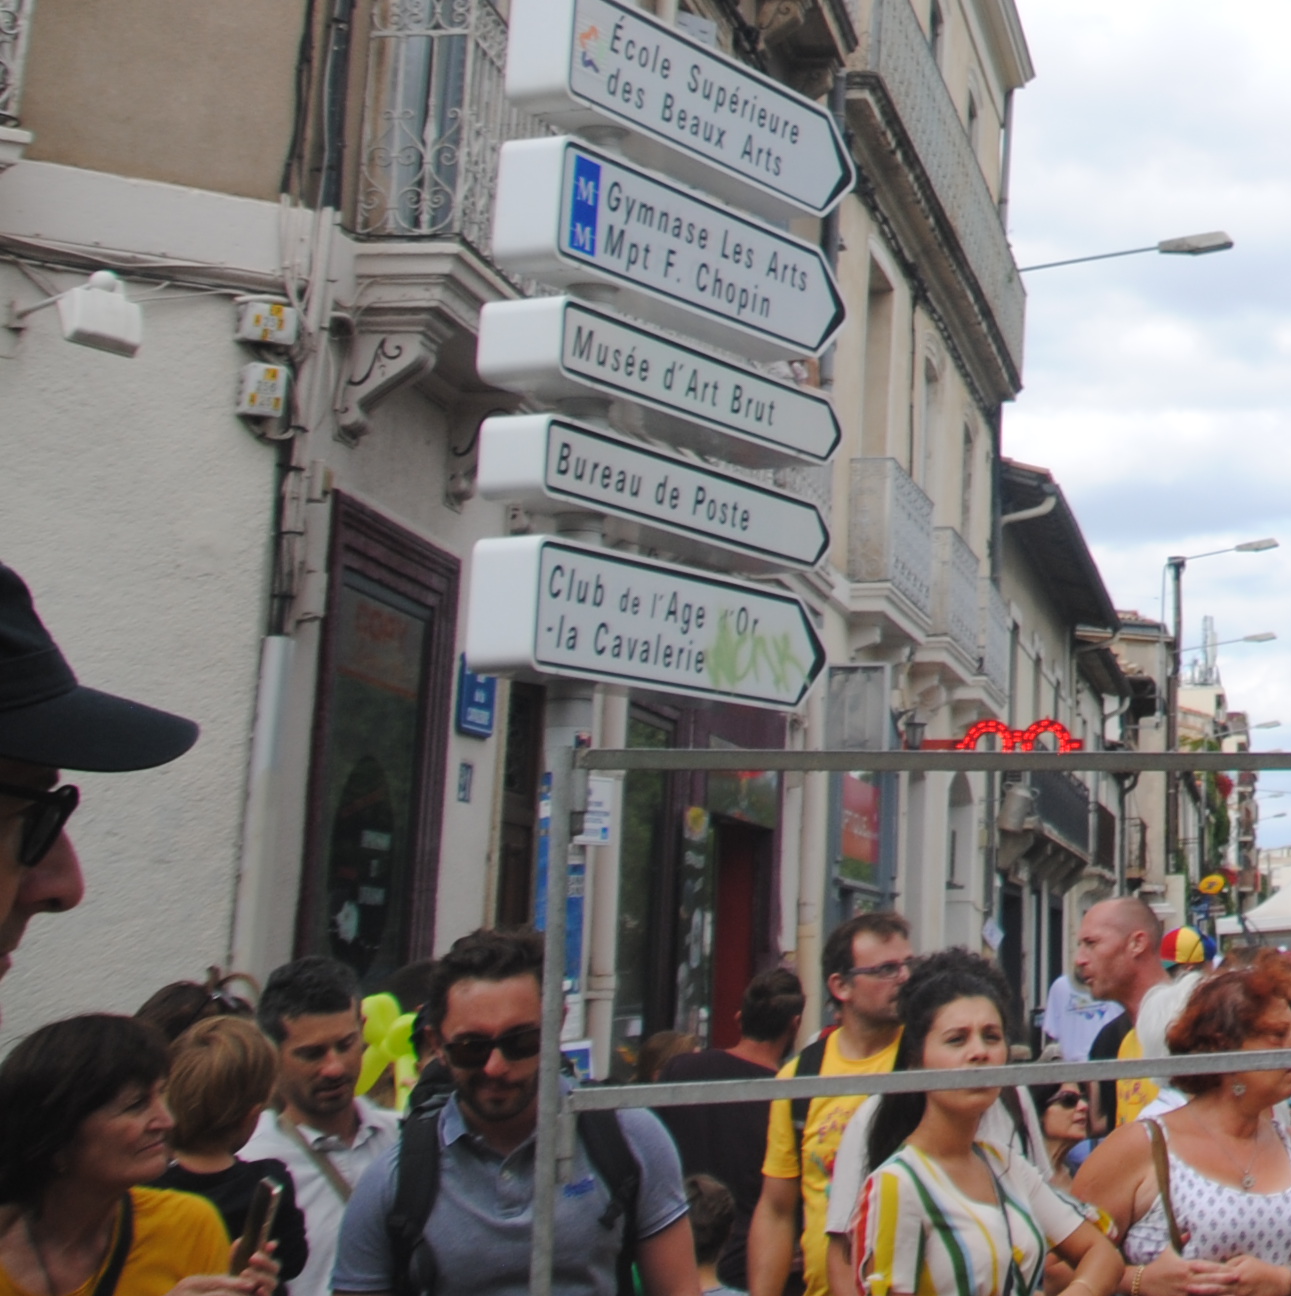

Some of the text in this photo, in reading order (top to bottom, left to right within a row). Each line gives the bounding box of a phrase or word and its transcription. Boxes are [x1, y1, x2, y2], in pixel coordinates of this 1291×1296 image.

[607, 68, 782, 176] des Beaux Arts
[608, 15, 799, 144] École Supérieure
[604, 225, 771, 319] Mpt F. Chopin
[607, 181, 808, 292] Gymnase Les Arts
[572, 325, 775, 426] Musée d'Art Brut
[557, 442, 750, 532] Bureau de Poste
[548, 564, 605, 606] Club
[619, 587, 639, 616] de
[546, 615, 578, 651] -la
[594, 623, 705, 674] Cavalerie
